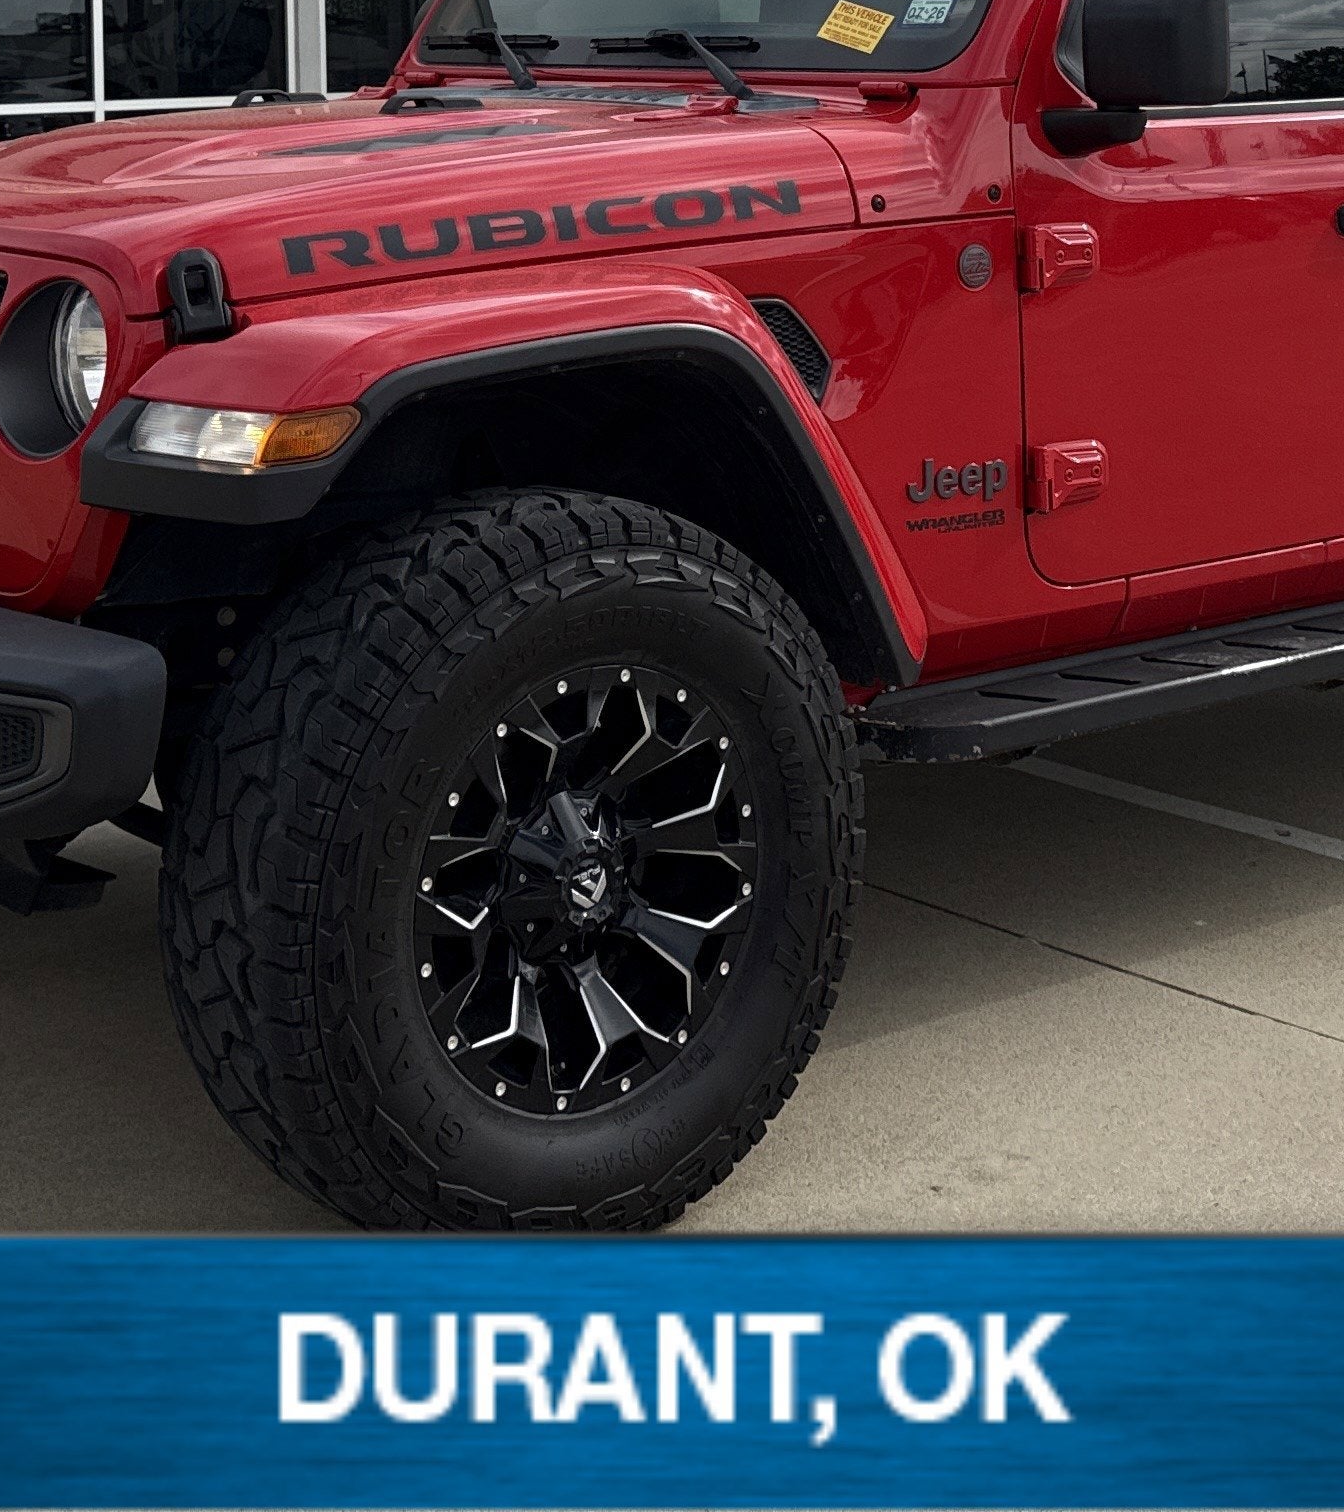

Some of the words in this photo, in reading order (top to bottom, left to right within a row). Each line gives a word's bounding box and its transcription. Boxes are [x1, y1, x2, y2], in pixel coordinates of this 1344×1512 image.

[838, 2, 857, 16] THIS
[856, 7, 890, 26] VEHICLE
[281, 179, 803, 276] RUBICON
[905, 458, 1008, 504] Jeep
[906, 508, 1005, 532] WRANGLER
[366, 756, 465, 1159] GLADIATOR
